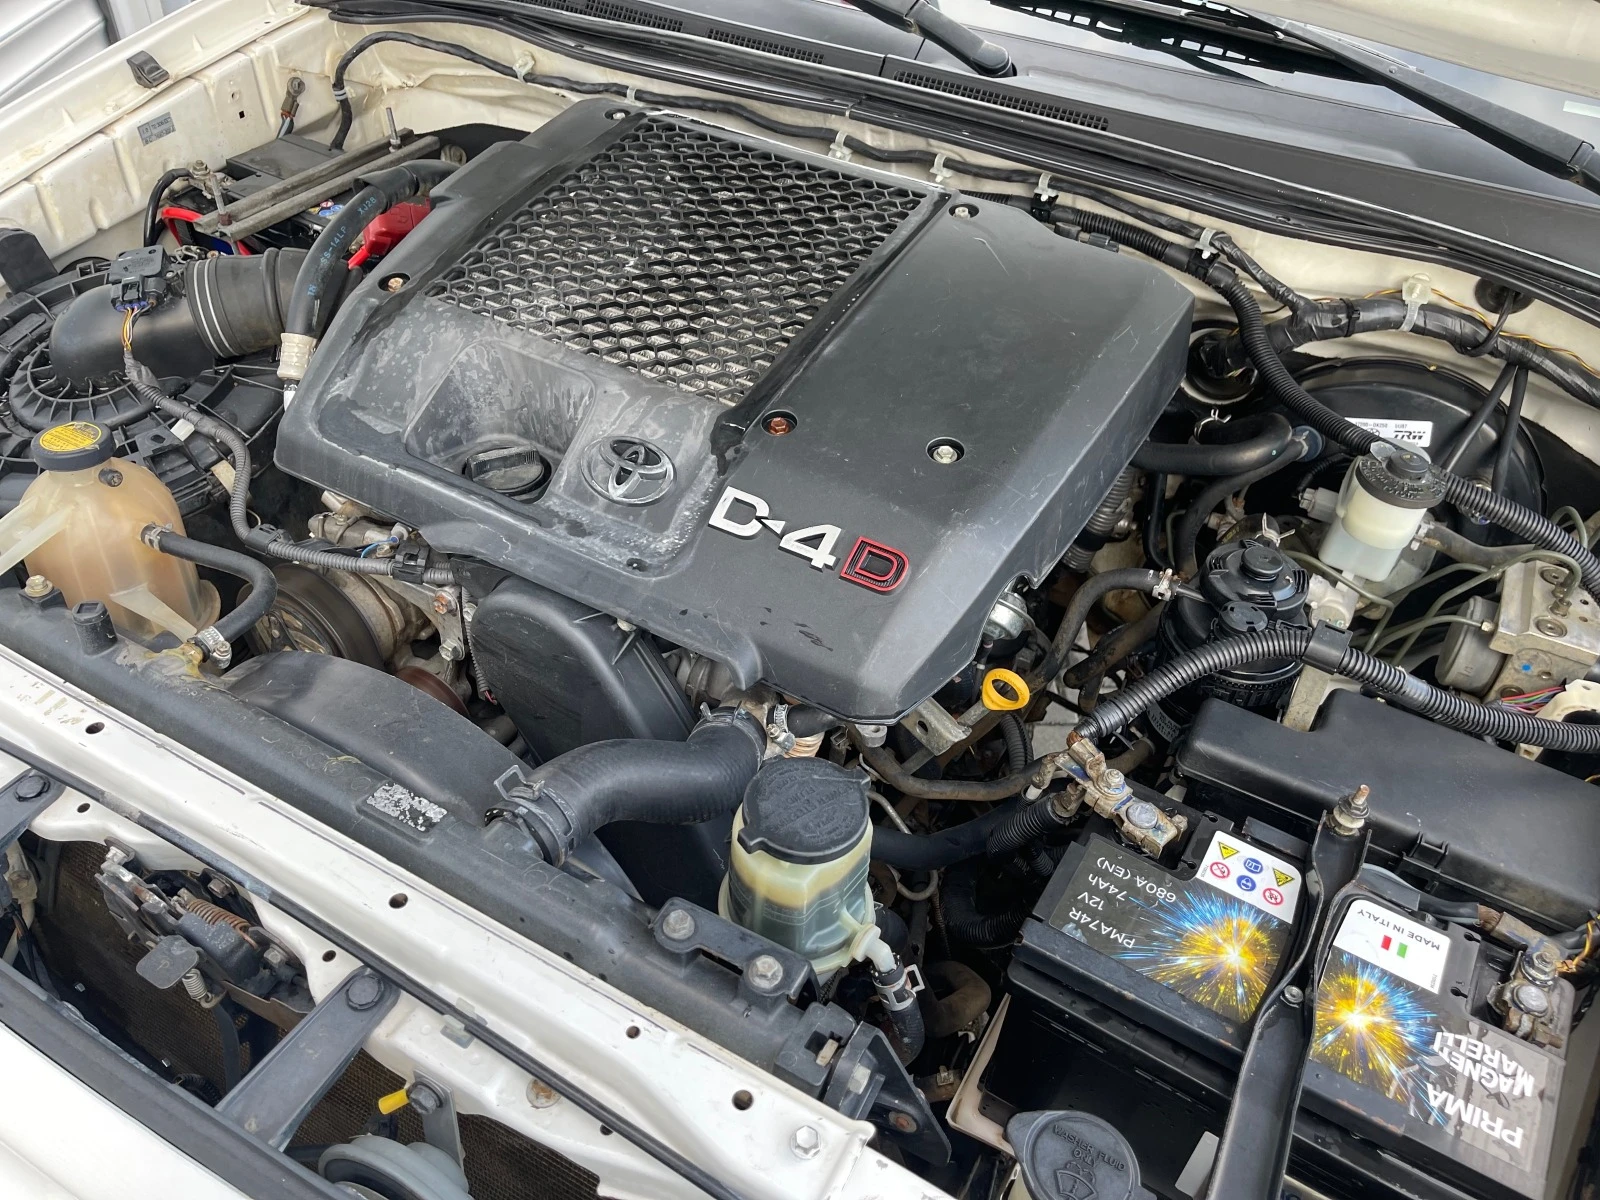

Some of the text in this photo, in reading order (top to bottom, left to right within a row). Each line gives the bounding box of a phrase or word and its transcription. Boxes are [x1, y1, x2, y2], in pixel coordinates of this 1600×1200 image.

[358, 196, 377, 215] XJ28
[1394, 430, 1426, 440] TRW
[1088, 873, 1127, 901] 74Ah
[1096, 857, 1176, 903] 680A (EN)
[1077, 892, 1104, 910] 12V
[1069, 907, 1136, 948] PMA74R
[1357, 909, 1440, 950] MADE IN ITALY
[1433, 1032, 1534, 1092] MARELLI
[1426, 1082, 1524, 1149] PRIMA
[1053, 1124, 1125, 1171] WASHER FLUID
[1073, 1148, 1097, 1168] ONLY
